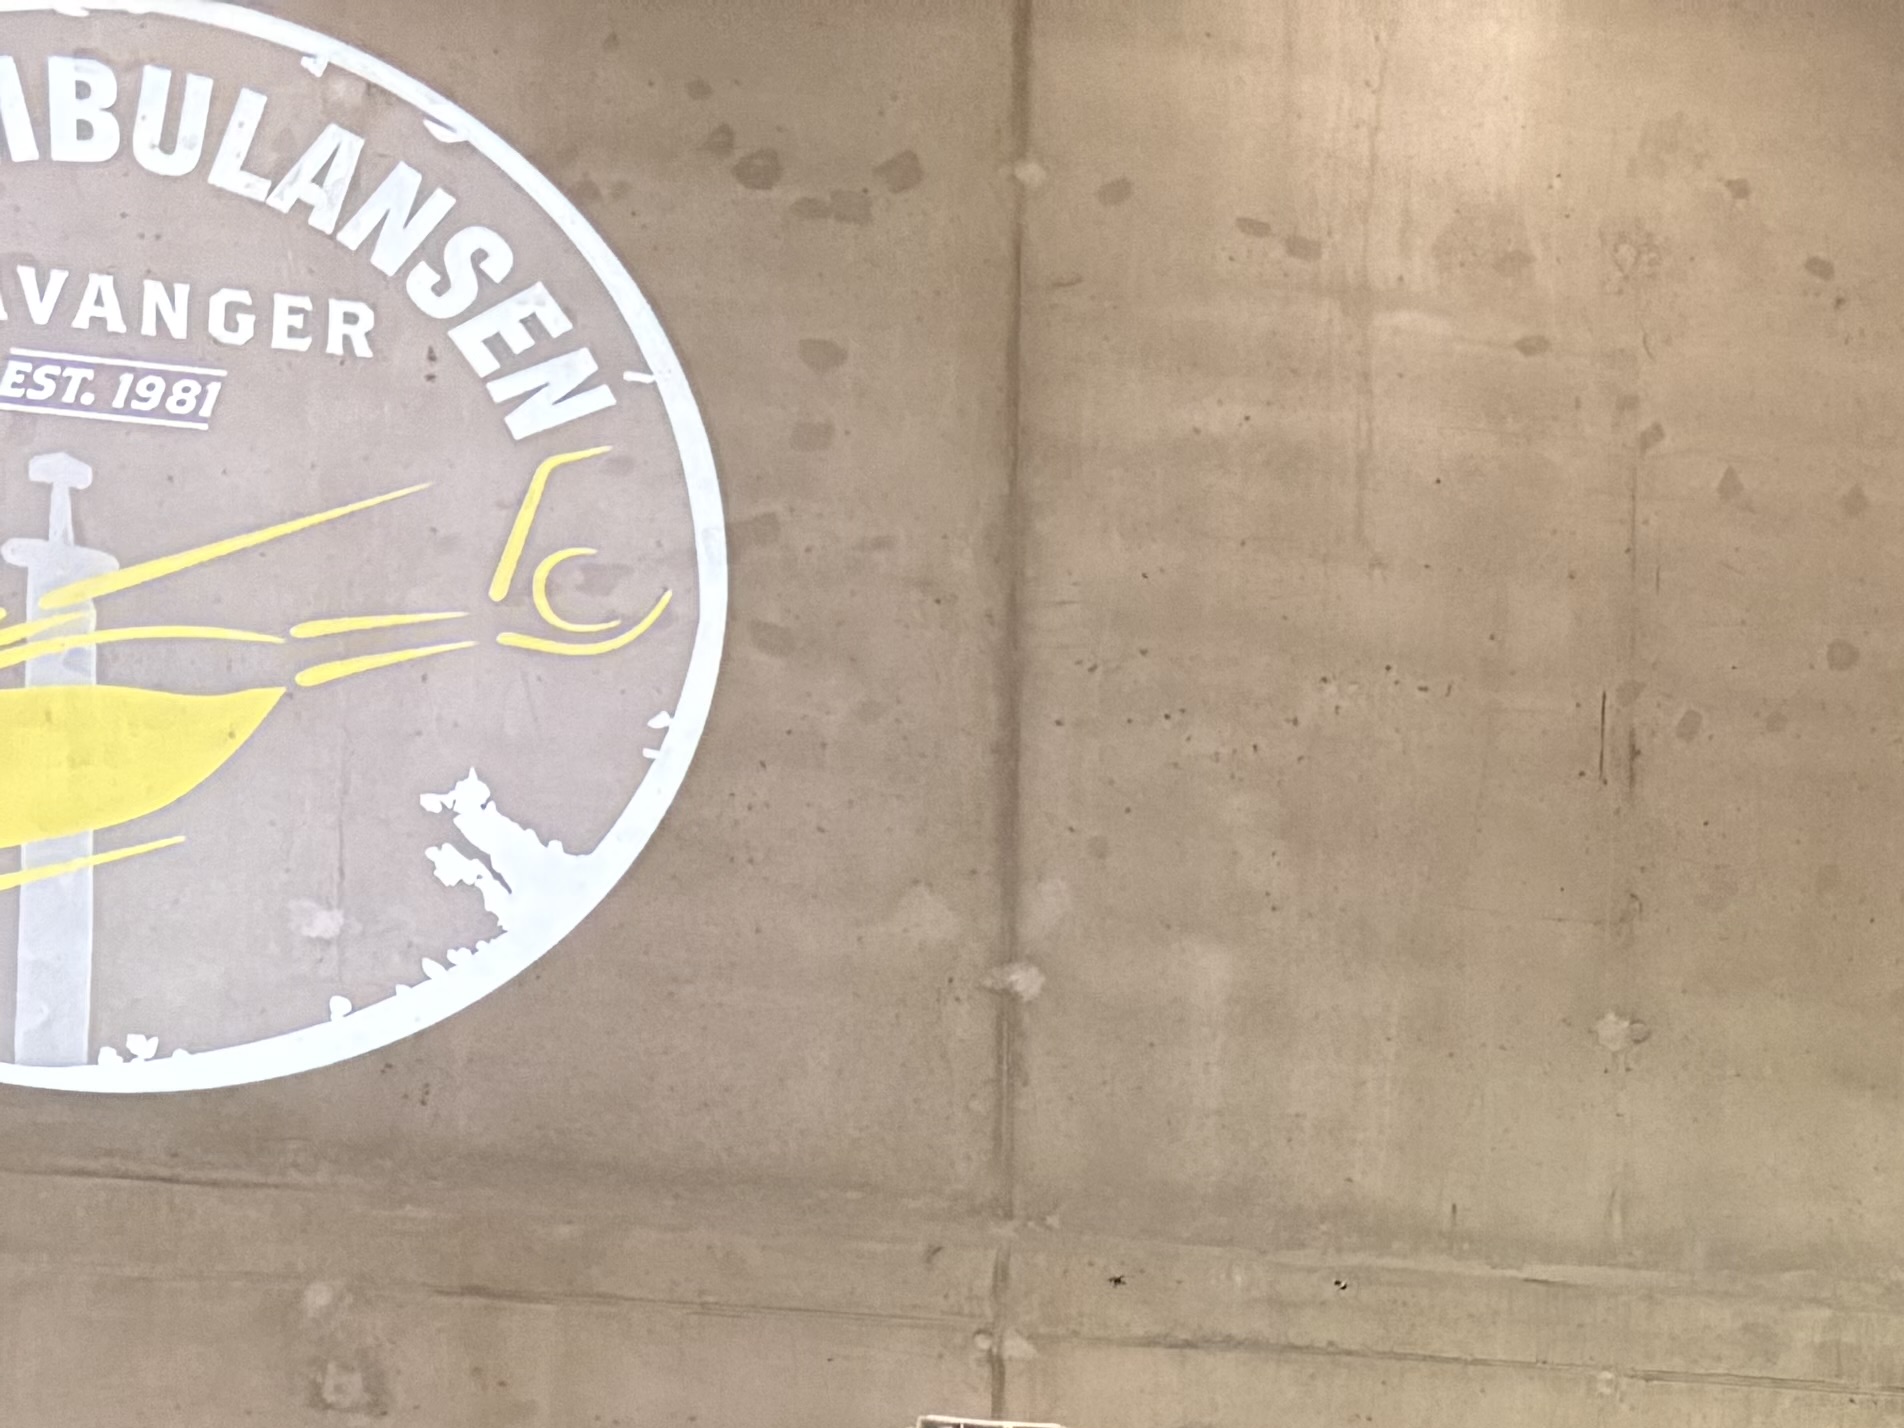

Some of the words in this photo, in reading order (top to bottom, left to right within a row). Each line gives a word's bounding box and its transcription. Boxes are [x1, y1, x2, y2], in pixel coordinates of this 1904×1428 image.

[0, 264, 374, 358] VANGER
[0, 360, 95, 406] EST.
[111, 373, 223, 417] 1981
